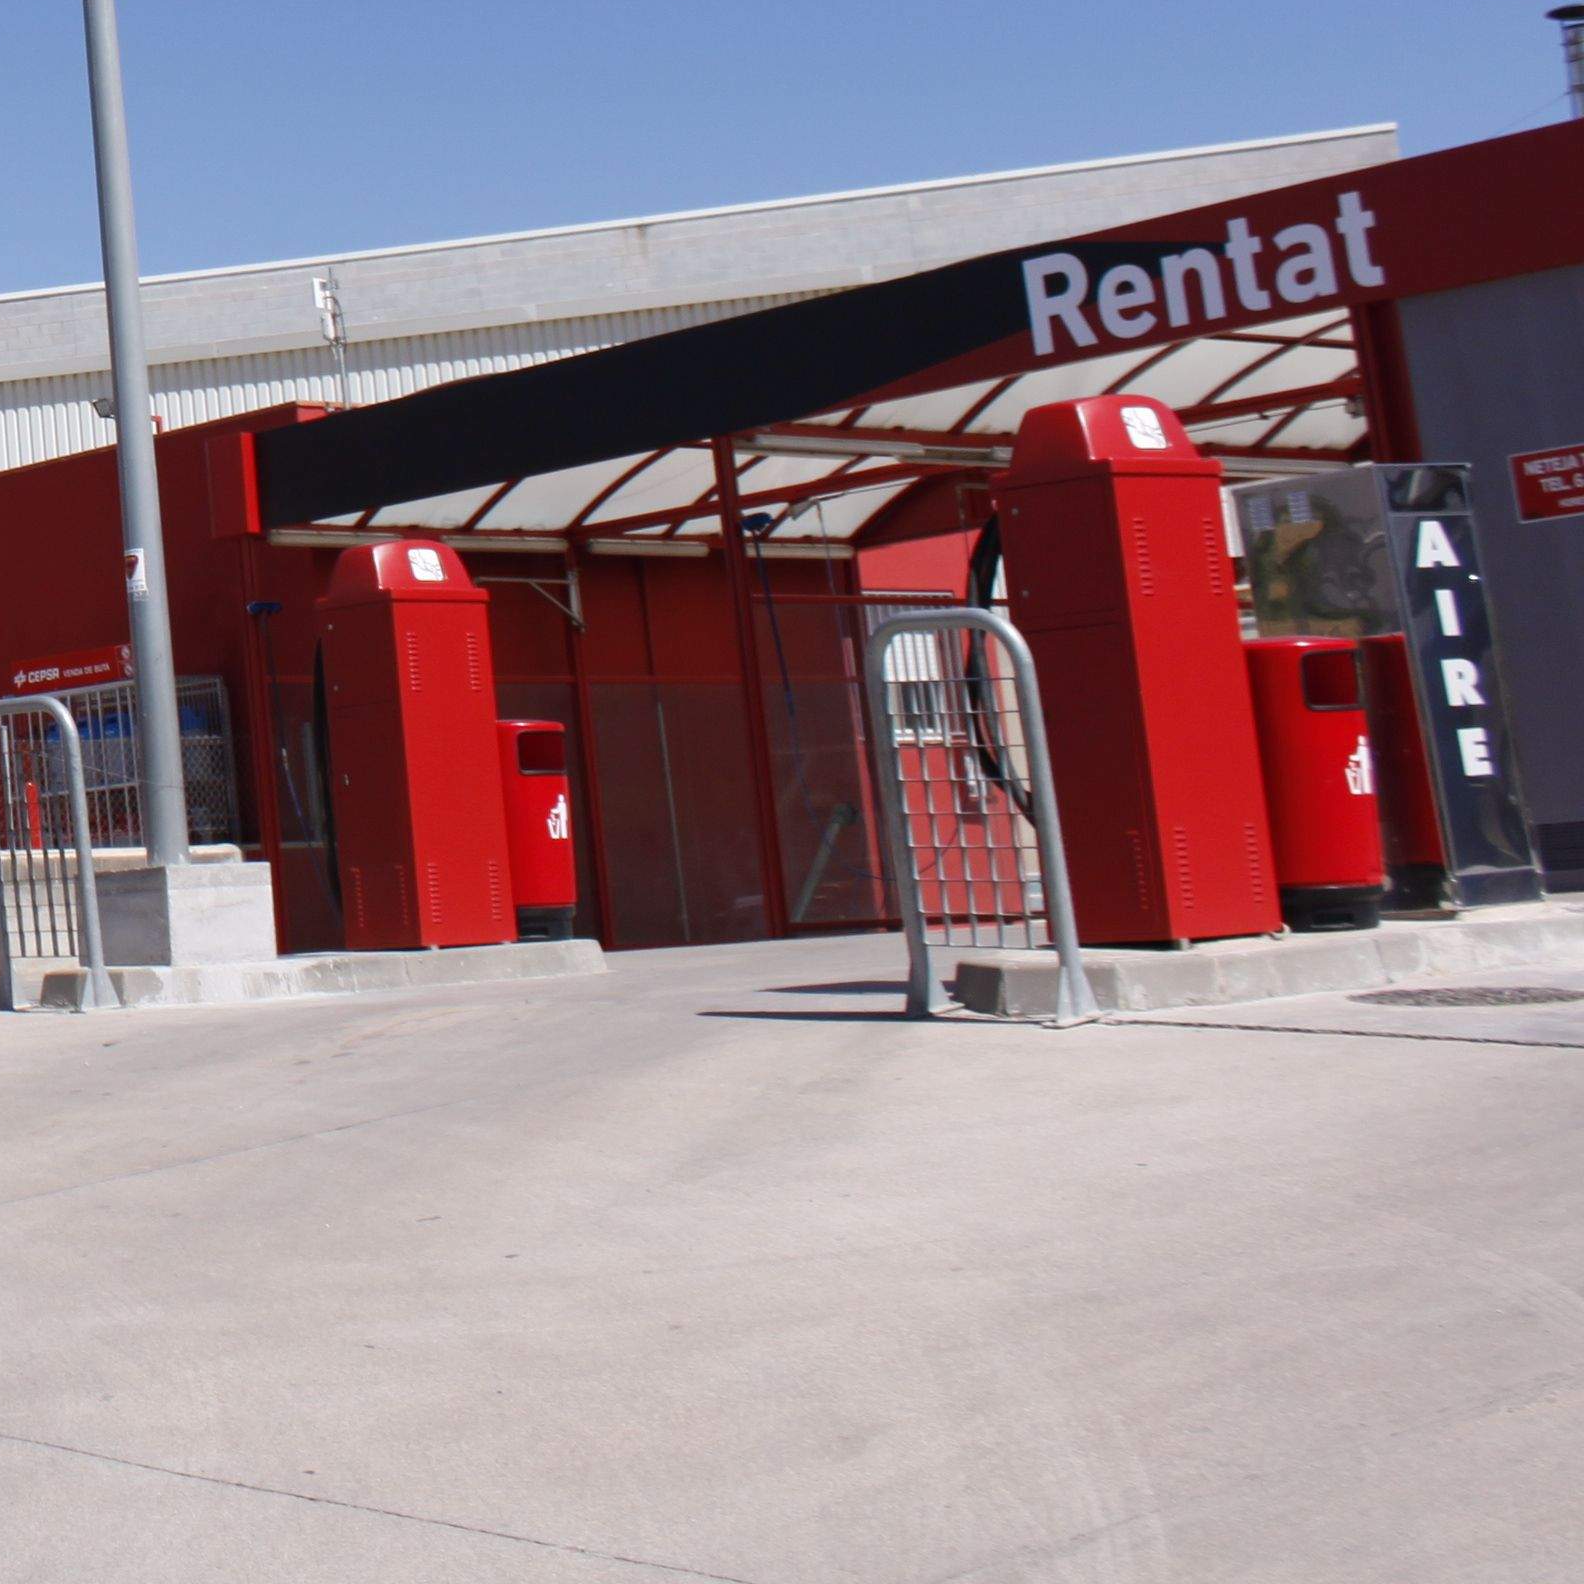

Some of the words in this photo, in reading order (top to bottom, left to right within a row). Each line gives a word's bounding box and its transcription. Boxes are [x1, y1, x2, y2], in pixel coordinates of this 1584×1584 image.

[1022, 191, 1386, 356] Rentat
[28, 667, 60, 683] CEPSA
[1416, 520, 1494, 777] AIRE
